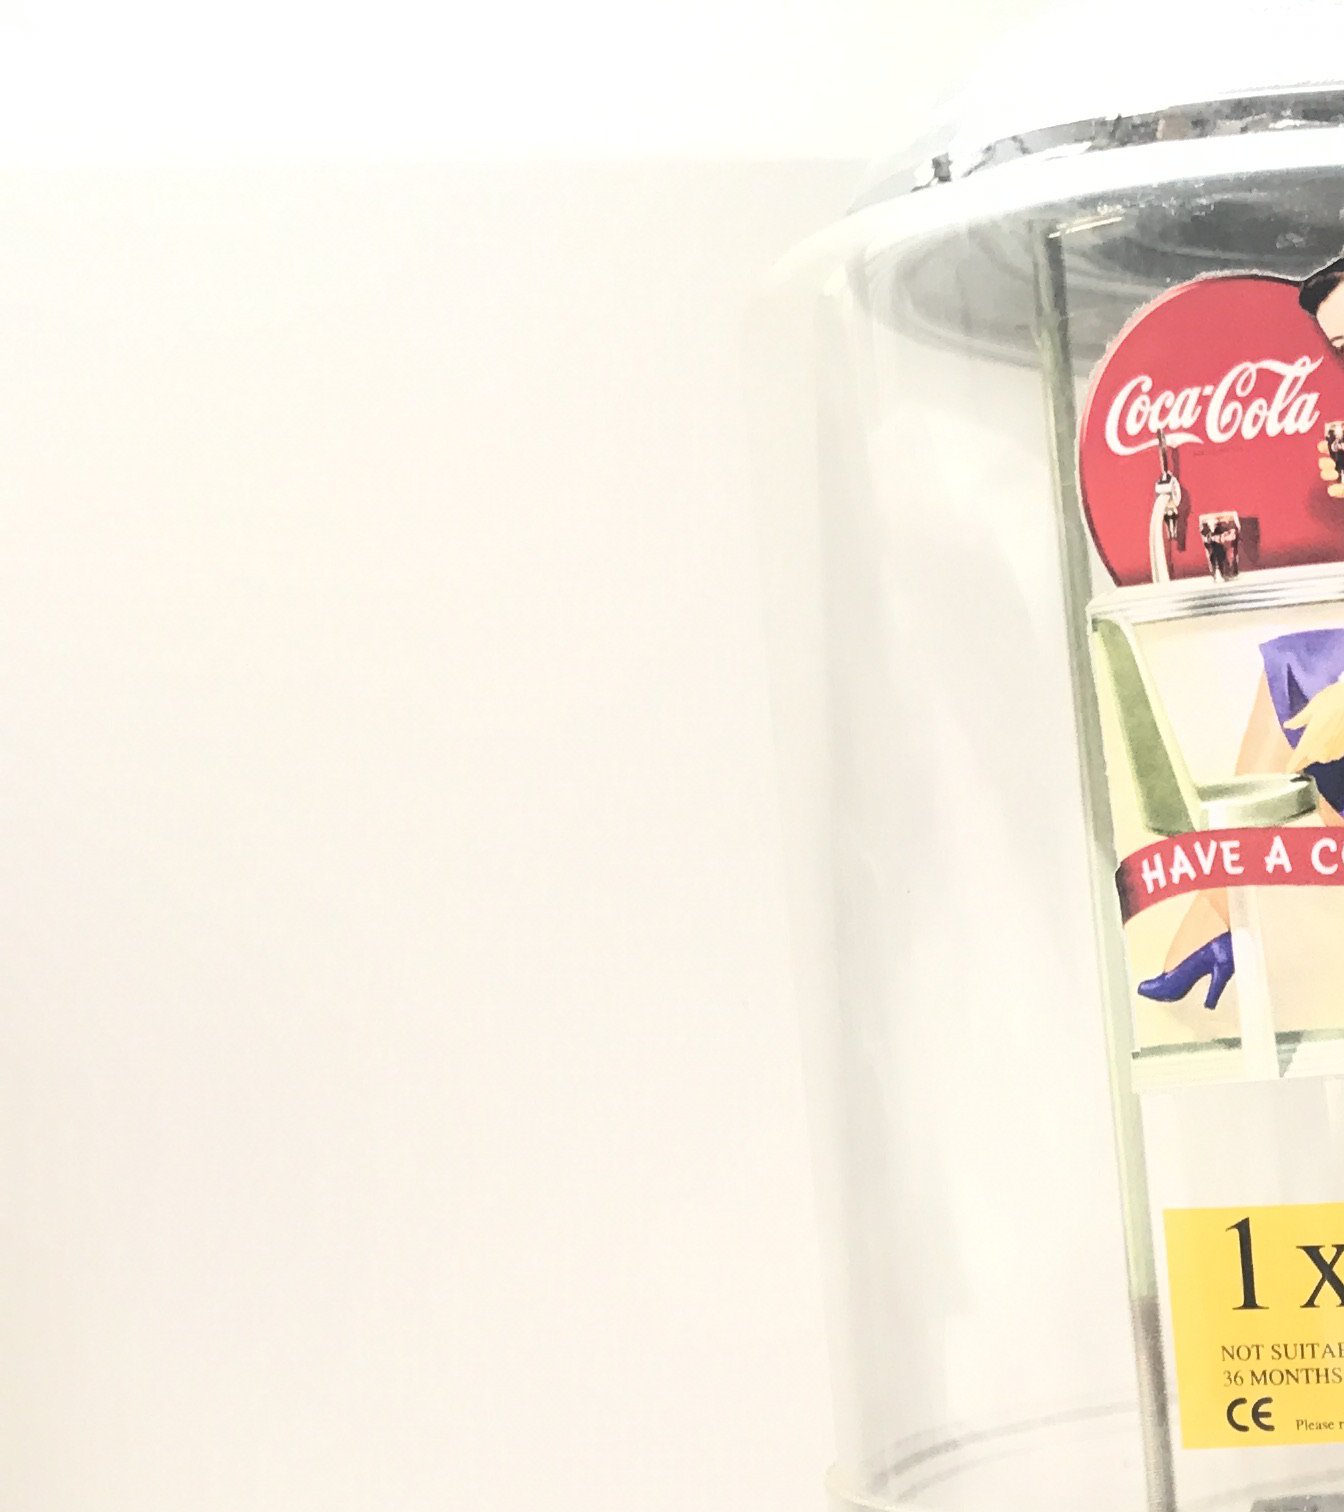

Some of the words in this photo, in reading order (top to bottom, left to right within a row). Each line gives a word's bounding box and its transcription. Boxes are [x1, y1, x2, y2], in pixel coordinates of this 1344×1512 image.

[1105, 355, 1324, 456] Coca-Cola
[1141, 839, 1245, 894] HAVE
[1263, 835, 1293, 874] A
[1221, 1344, 1265, 1362] NOT
[1223, 1369, 1244, 1387] 36
[1250, 1366, 1343, 1386] MONTHS
[1295, 1418, 1335, 1431] Please
